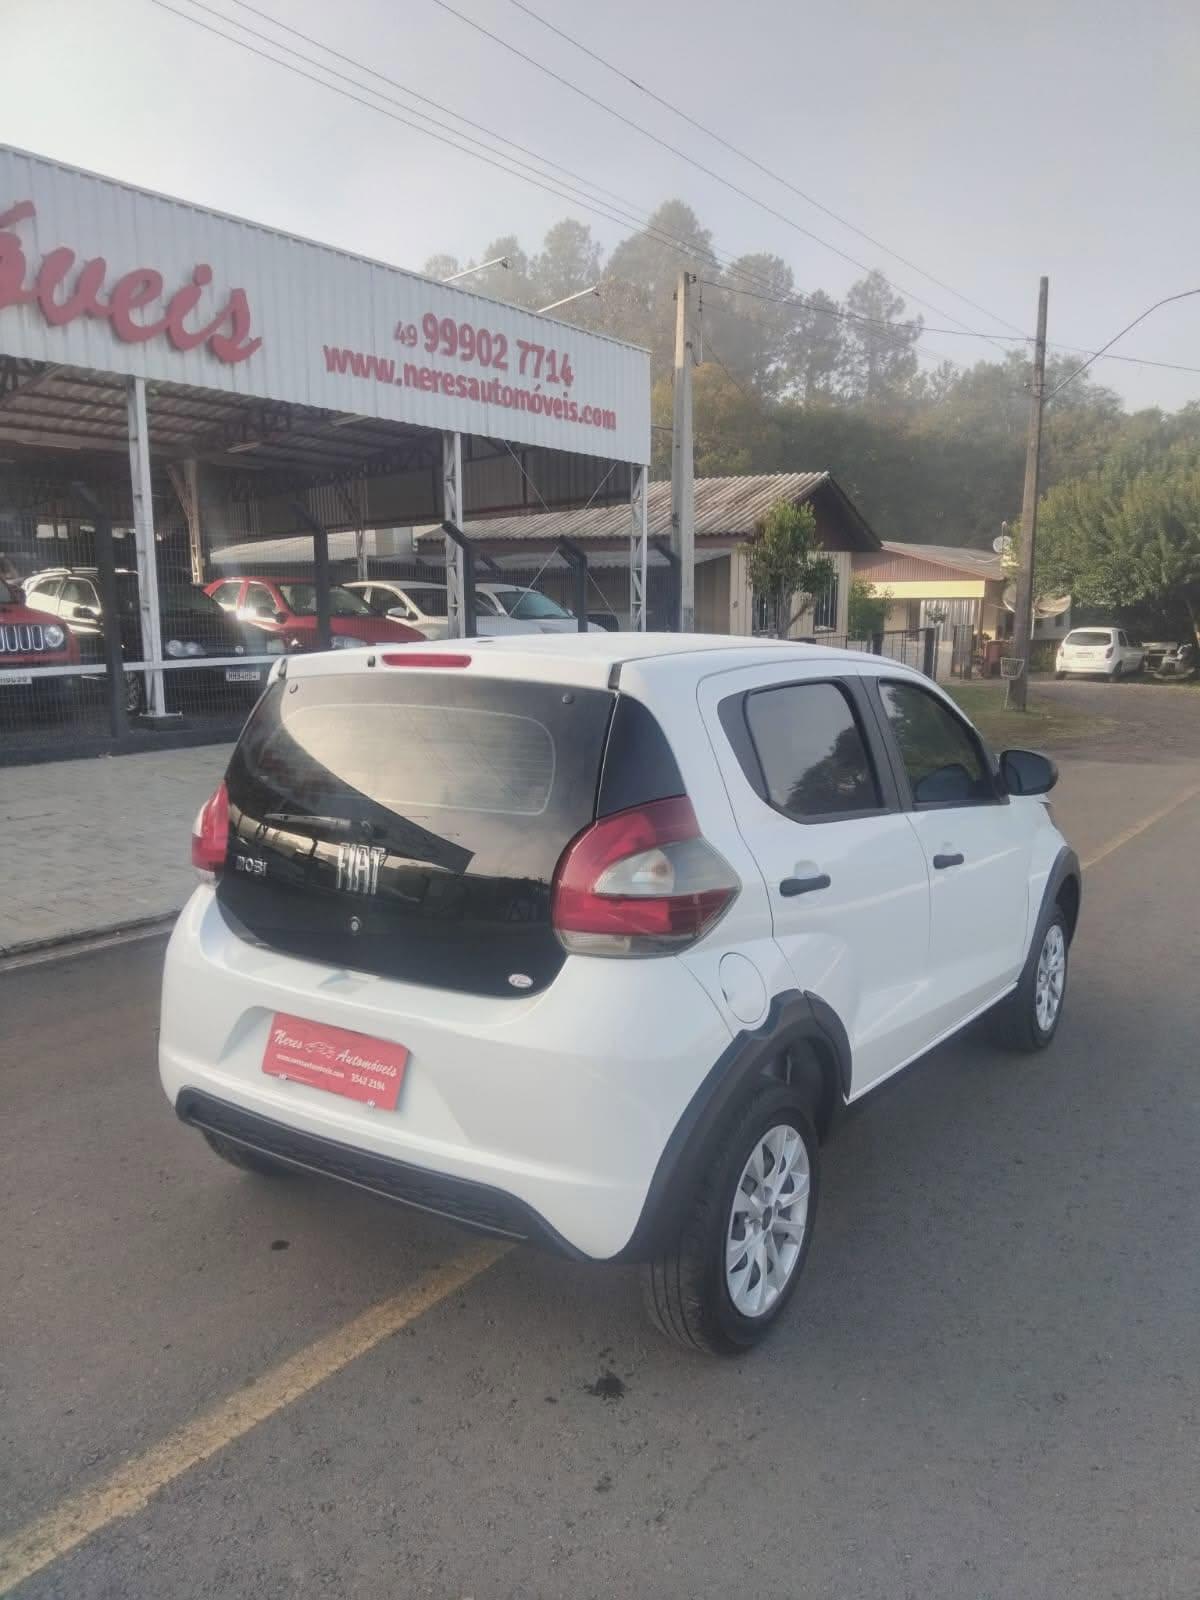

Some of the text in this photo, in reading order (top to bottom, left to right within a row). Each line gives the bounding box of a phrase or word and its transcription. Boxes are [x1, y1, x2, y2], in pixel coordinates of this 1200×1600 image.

[394, 312, 574, 386] 49 99902 7714
[323, 345, 616, 430] www.neresautomóveis.com
[336, 842, 386, 895] FIAT
[335, 1048, 398, 1077] Automóveis
